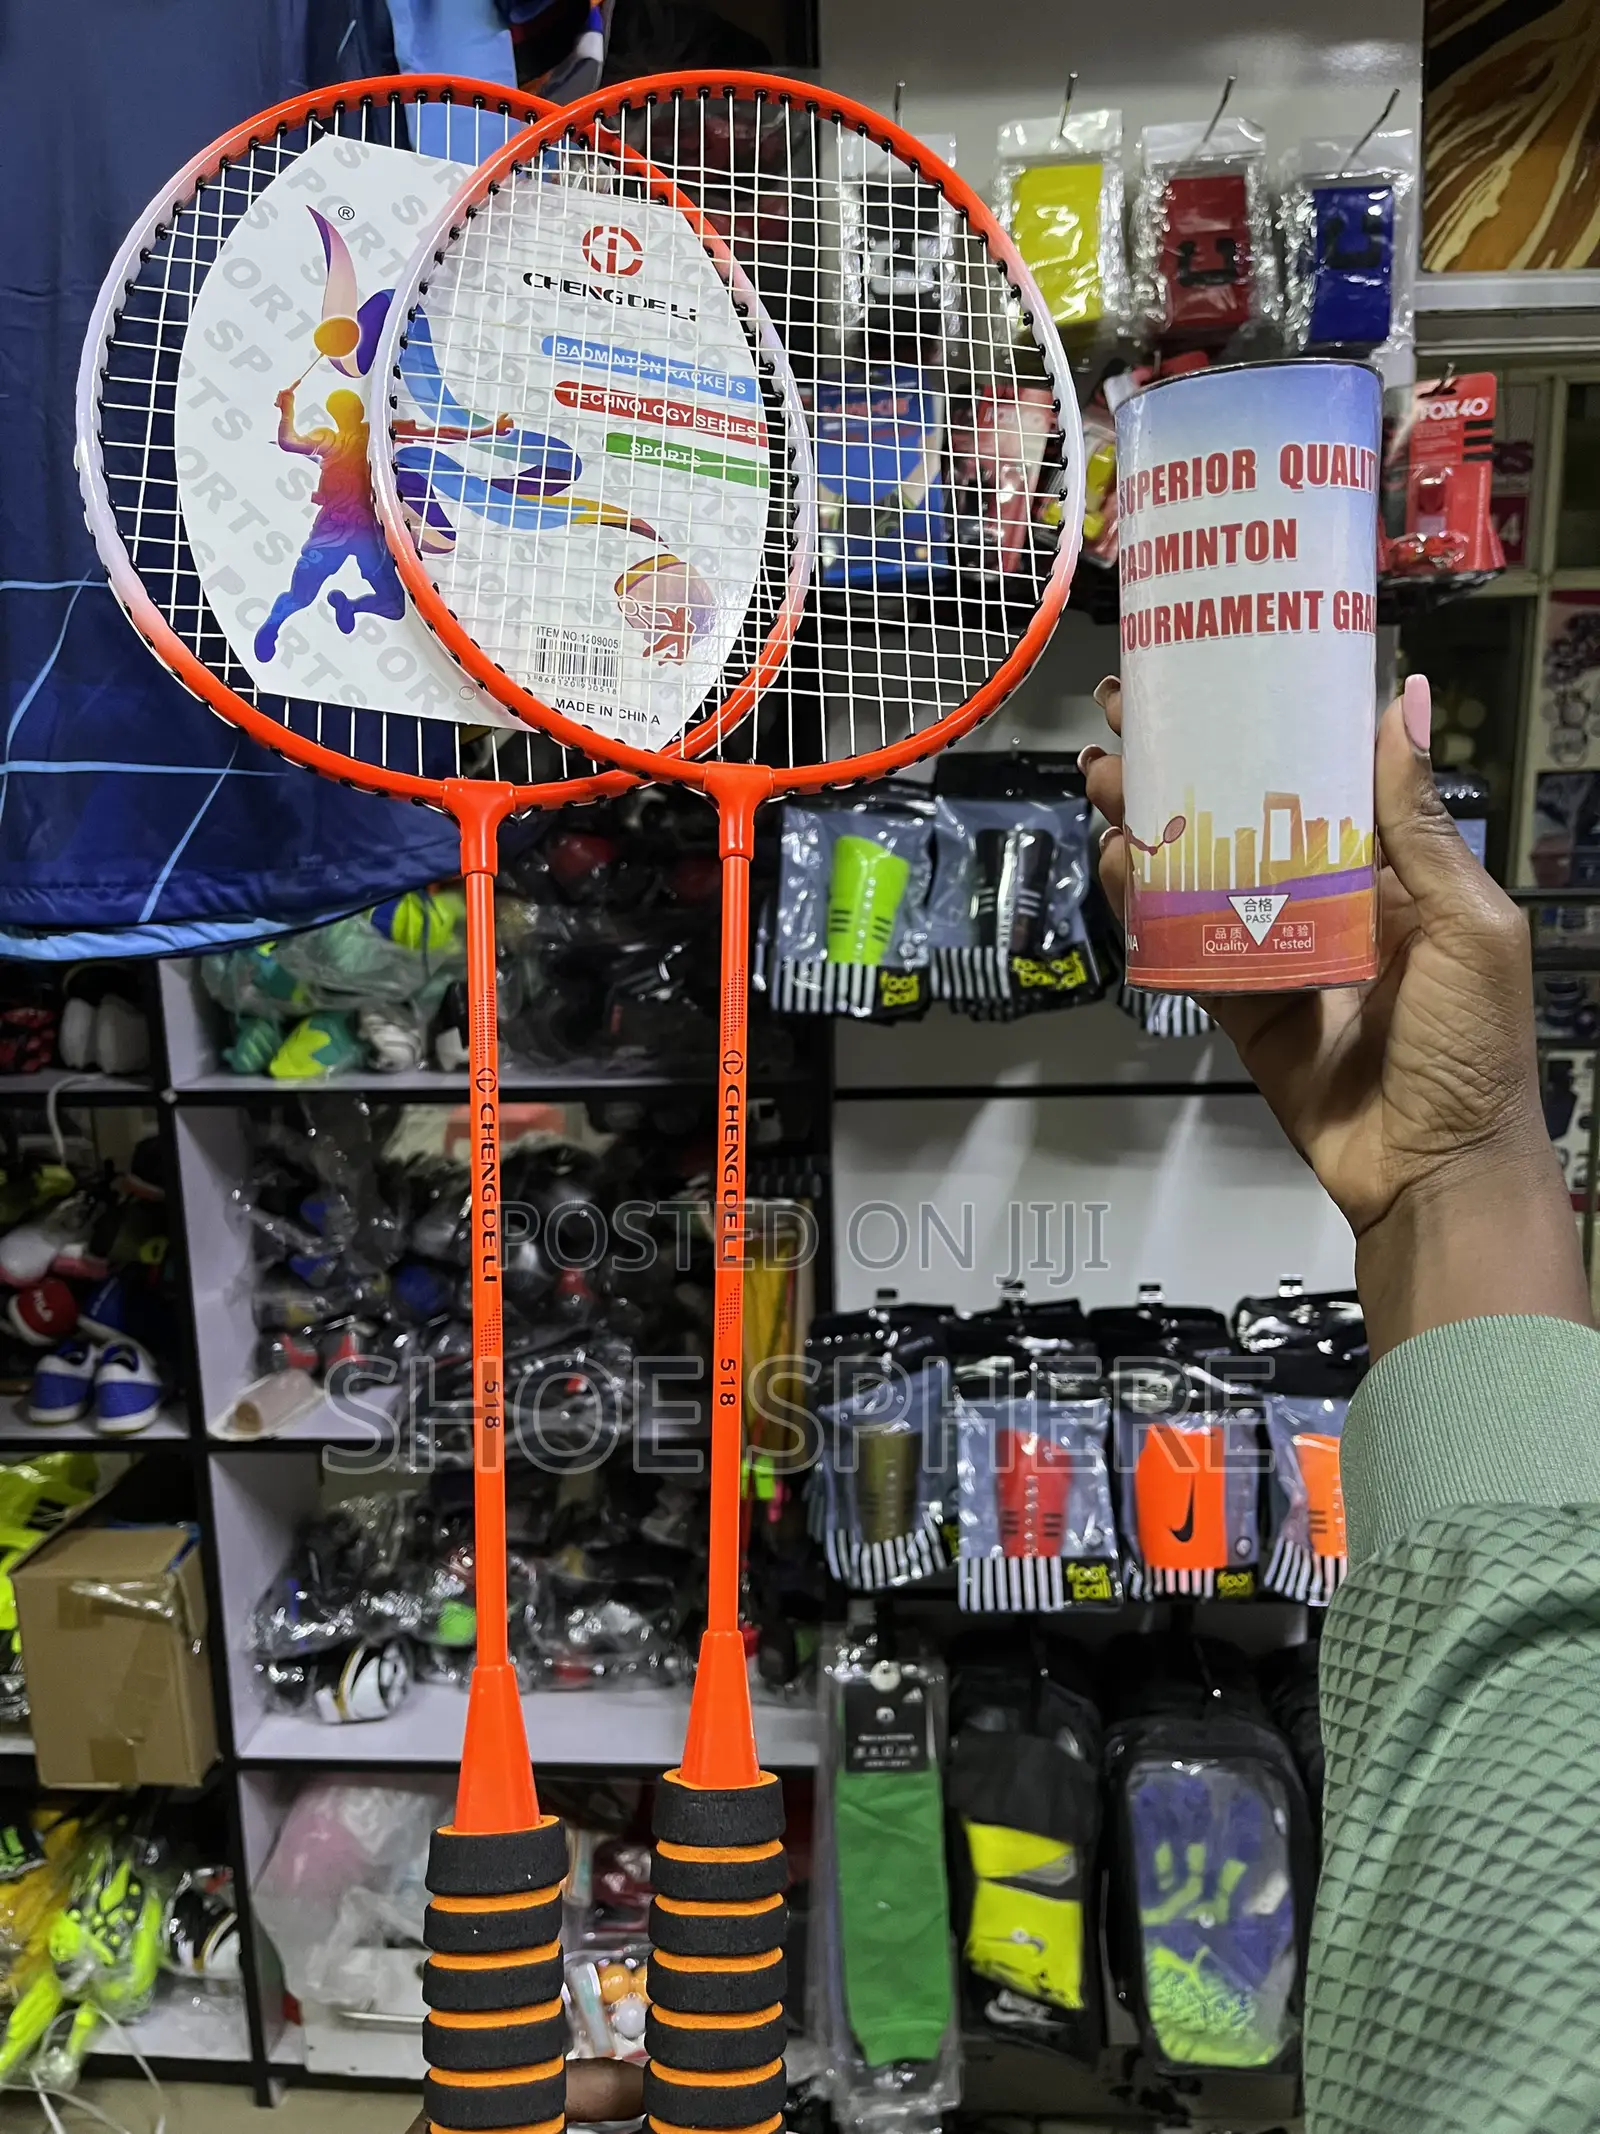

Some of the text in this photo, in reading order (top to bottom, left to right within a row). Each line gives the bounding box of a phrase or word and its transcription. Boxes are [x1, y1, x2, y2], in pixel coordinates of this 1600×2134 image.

[556, 341, 747, 395] BADMINTON RACKETS
[568, 387, 758, 440] TECHNOLOGY SERIES
[630, 441, 701, 469] SPORTS
[1118, 448, 1257, 519] SUPERIOR
[536, 626, 560, 638] ITEM
[556, 698, 661, 726] MADE IN CHINA
[1244, 898, 1272, 912] 合格
[1246, 914, 1272, 923] PASS
[1205, 937, 1312, 953] Quality Tested
[480, 1103, 497, 1282] CHENGDELI
[722, 1084, 741, 1262] CHENGDELI
[483, 1379, 501, 1430] 518
[719, 1358, 736, 1406] 518
